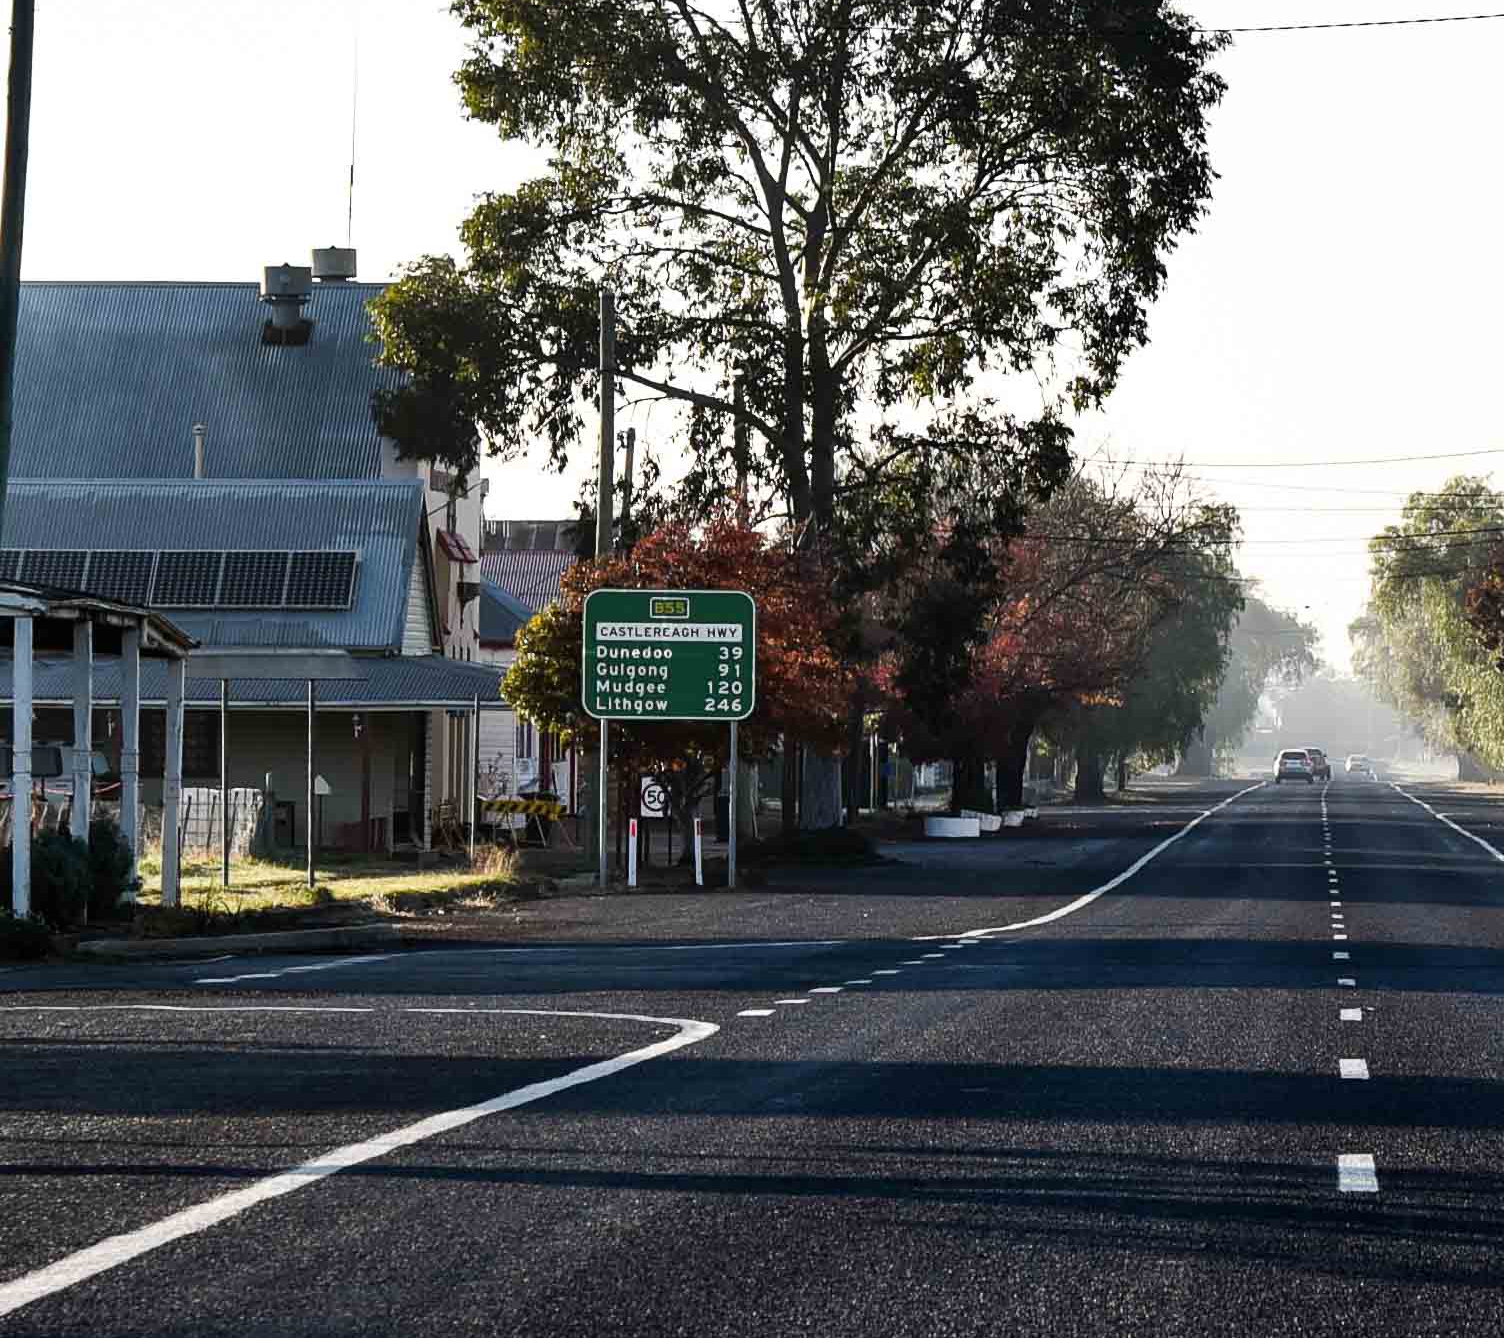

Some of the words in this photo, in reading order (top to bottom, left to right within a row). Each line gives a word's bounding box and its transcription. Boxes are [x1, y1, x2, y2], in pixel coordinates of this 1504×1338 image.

[655, 602, 686, 614] B55
[600, 627, 699, 637] CASTLEREAGH
[707, 627, 737, 638] HWY
[596, 645, 673, 659] Dunedoo
[719, 646, 743, 660] 39
[596, 663, 668, 680] Gulgong
[718, 663, 741, 677] 91
[596, 680, 667, 696] Mudgee
[707, 681, 743, 695] 120
[596, 697, 668, 714] Lithgow
[704, 698, 742, 712] 246
